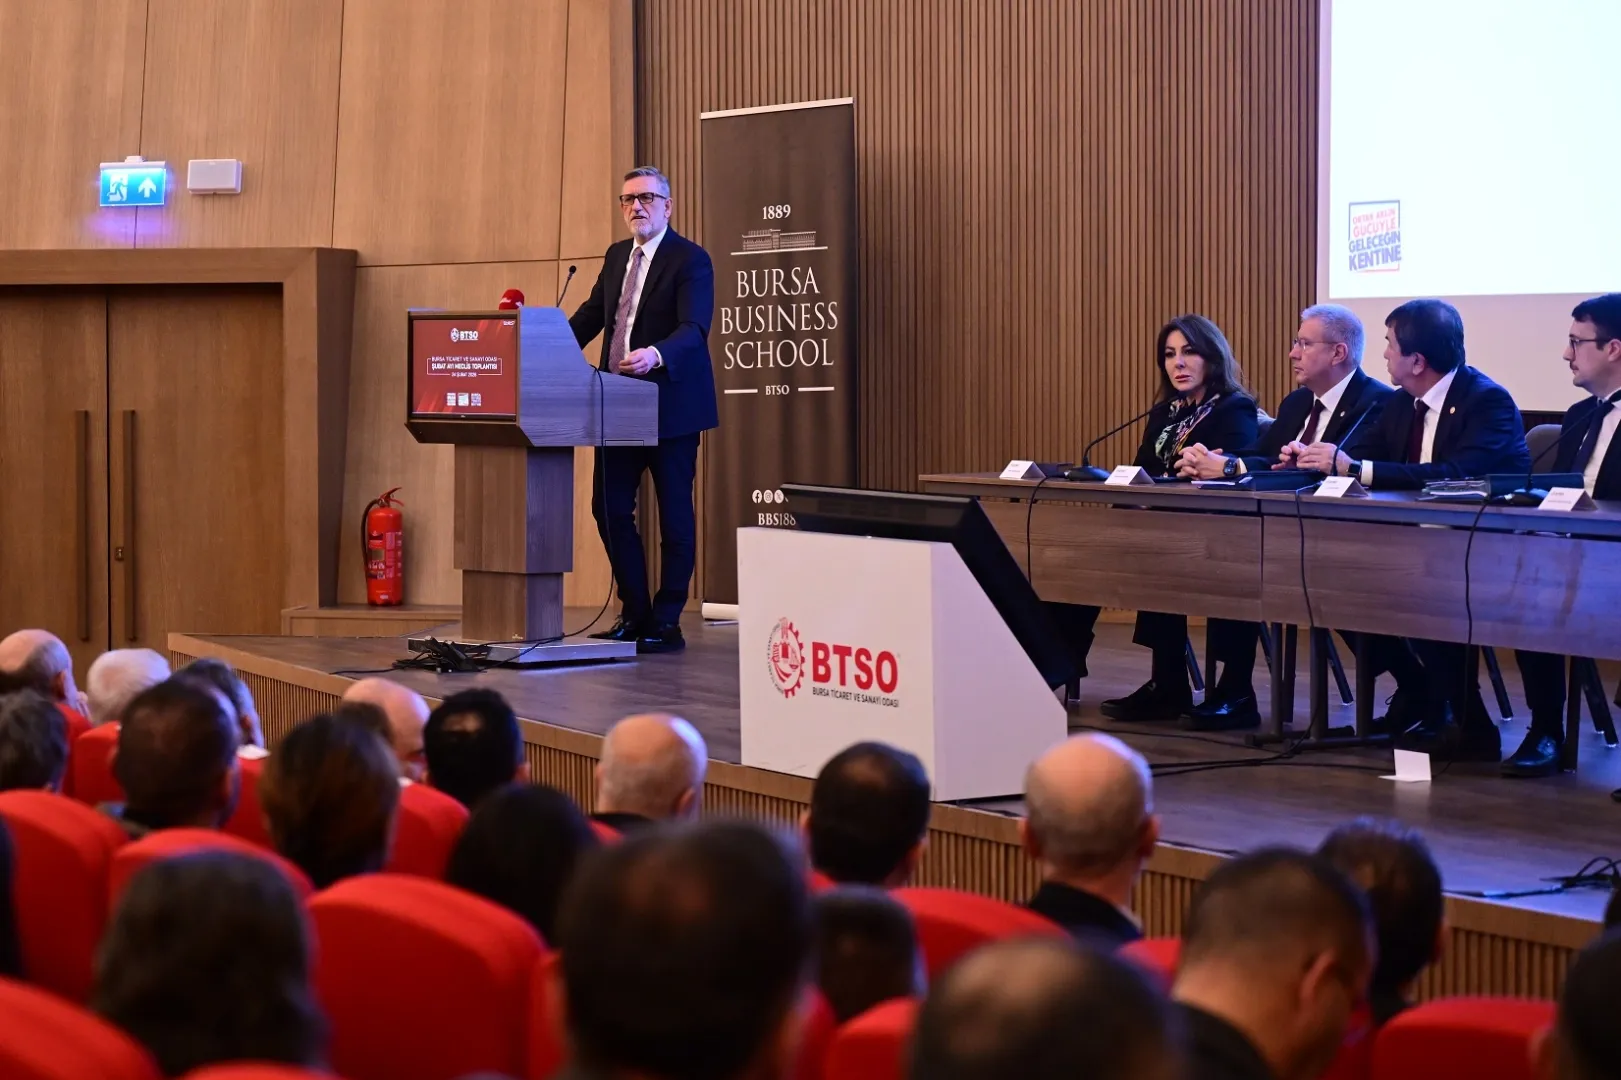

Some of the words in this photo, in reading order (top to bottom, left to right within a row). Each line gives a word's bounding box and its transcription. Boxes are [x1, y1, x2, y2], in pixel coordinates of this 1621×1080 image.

[762, 204, 791, 220] 1889
[736, 266, 820, 299] BURSA
[720, 301, 839, 335] BUSINESS
[724, 338, 835, 370] SCHOOL
[765, 384, 790, 396] BTSO
[812, 641, 898, 694] BTSO
[812, 686, 830, 697] BURSA
[830, 688, 852, 701] TİCARET
[853, 693, 861, 703] VE
[881, 697, 900, 708] ODASI
